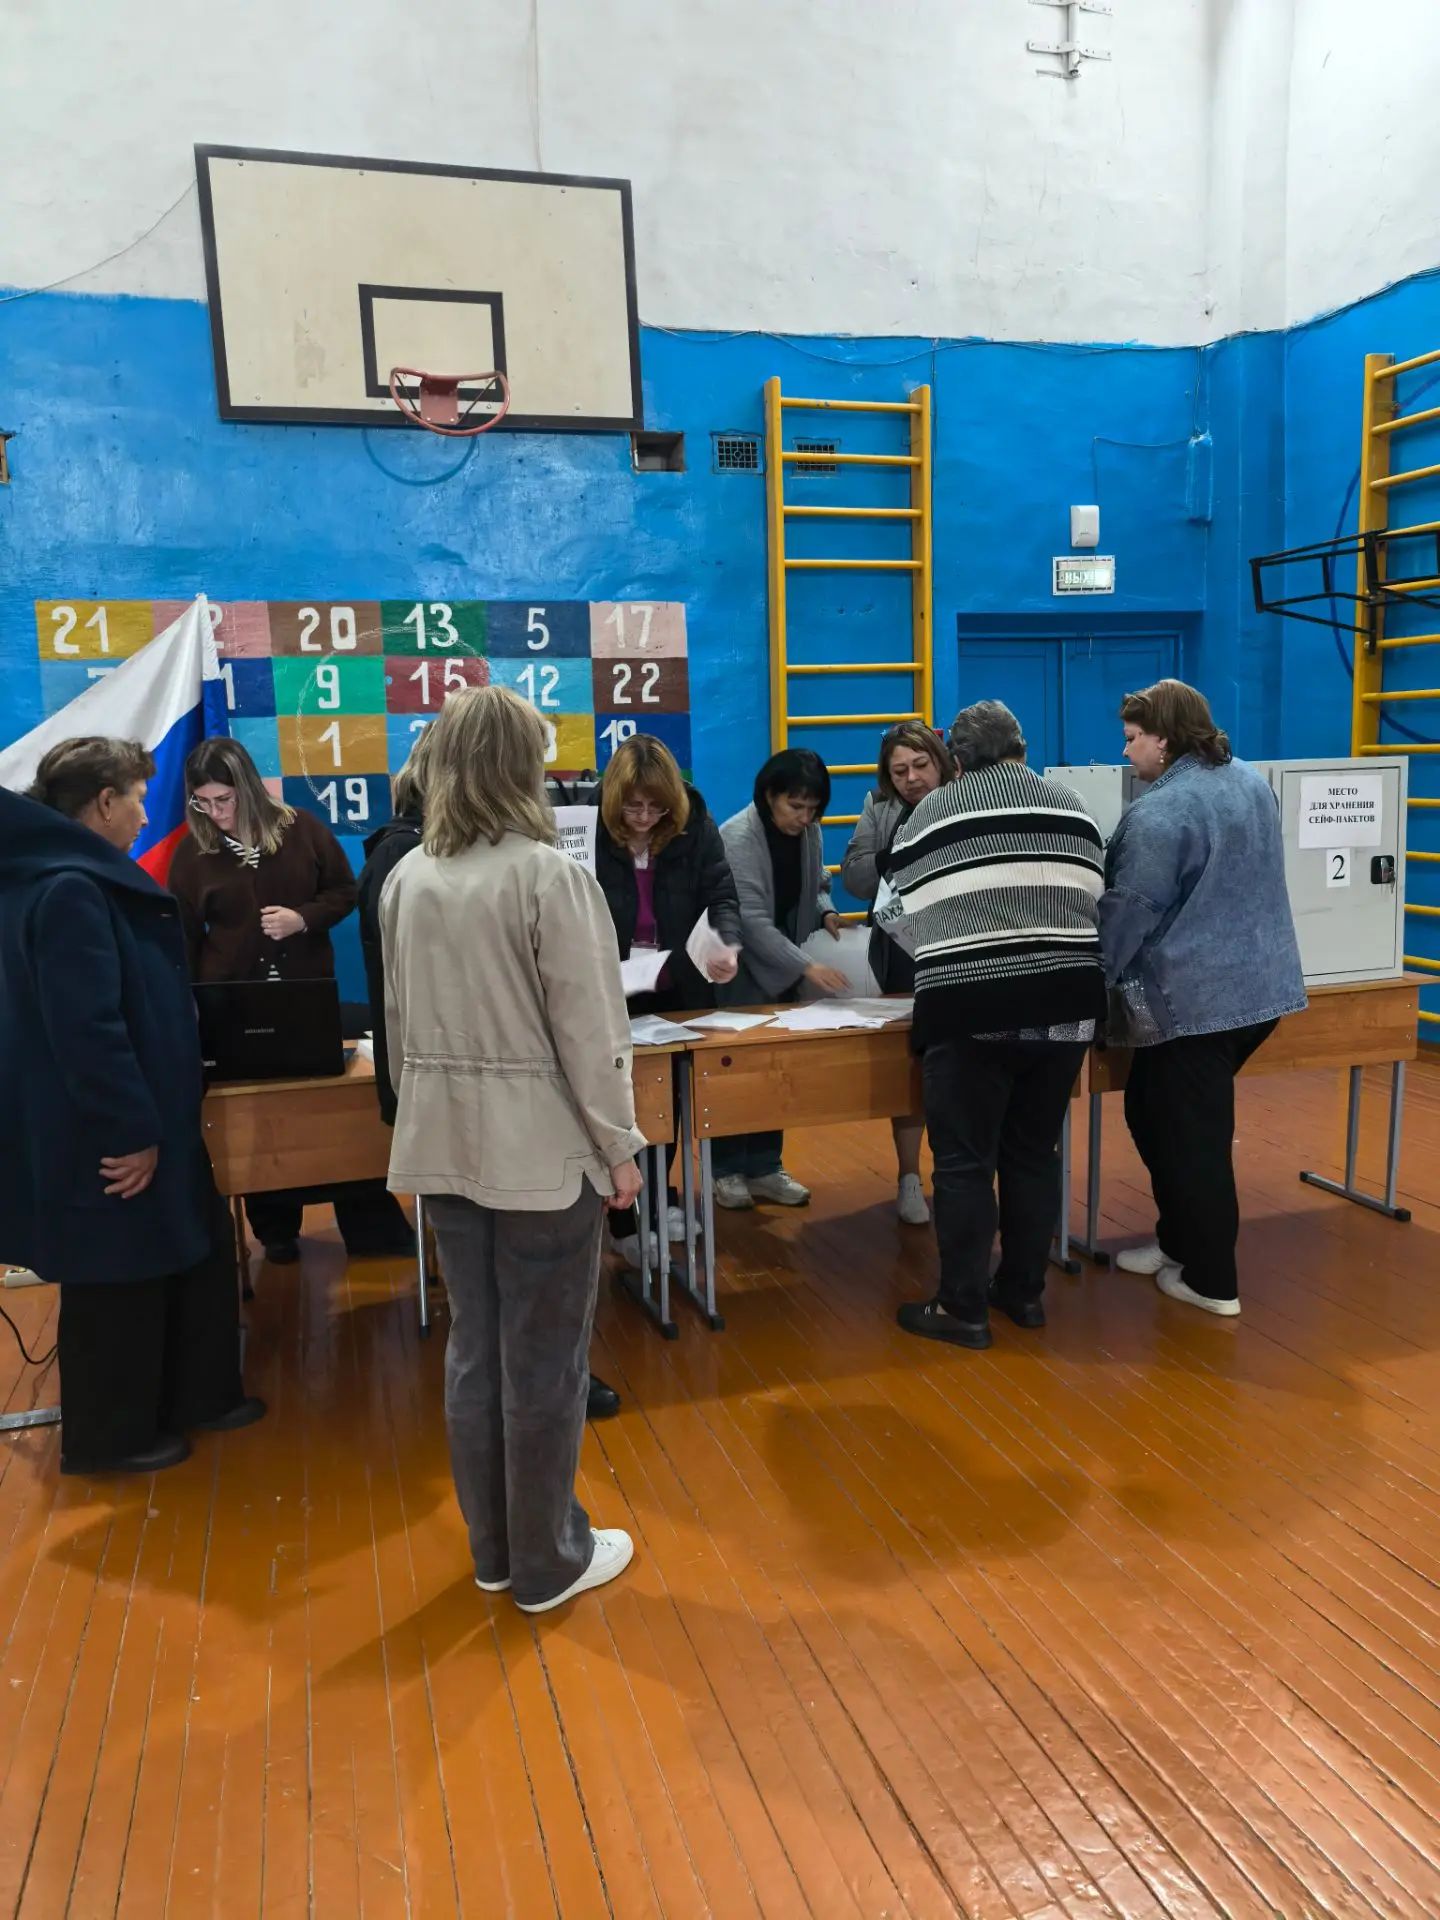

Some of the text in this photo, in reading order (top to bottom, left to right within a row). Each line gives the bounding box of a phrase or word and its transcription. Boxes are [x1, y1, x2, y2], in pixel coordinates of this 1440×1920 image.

[51, 606, 110, 655] 21
[298, 606, 357, 651] 20
[403, 603, 459, 650] 13
[527, 607, 550, 650] 5
[604, 604, 654, 648] 17
[316, 664, 341, 709] 9
[409, 659, 467, 705] 15
[516, 664, 560, 707] 12
[612, 663, 660, 705] 22
[317, 721, 342, 767] 1
[318, 777, 369, 823] 19
[1309, 801, 1375, 811] ДЛЯ ХРАНЕНИЯ
[1328, 787, 1358, 796] МЕСТО
[1308, 814, 1375, 824] СЕЙФ-ПАКЕТОВ
[1332, 854, 1345, 880] 2
